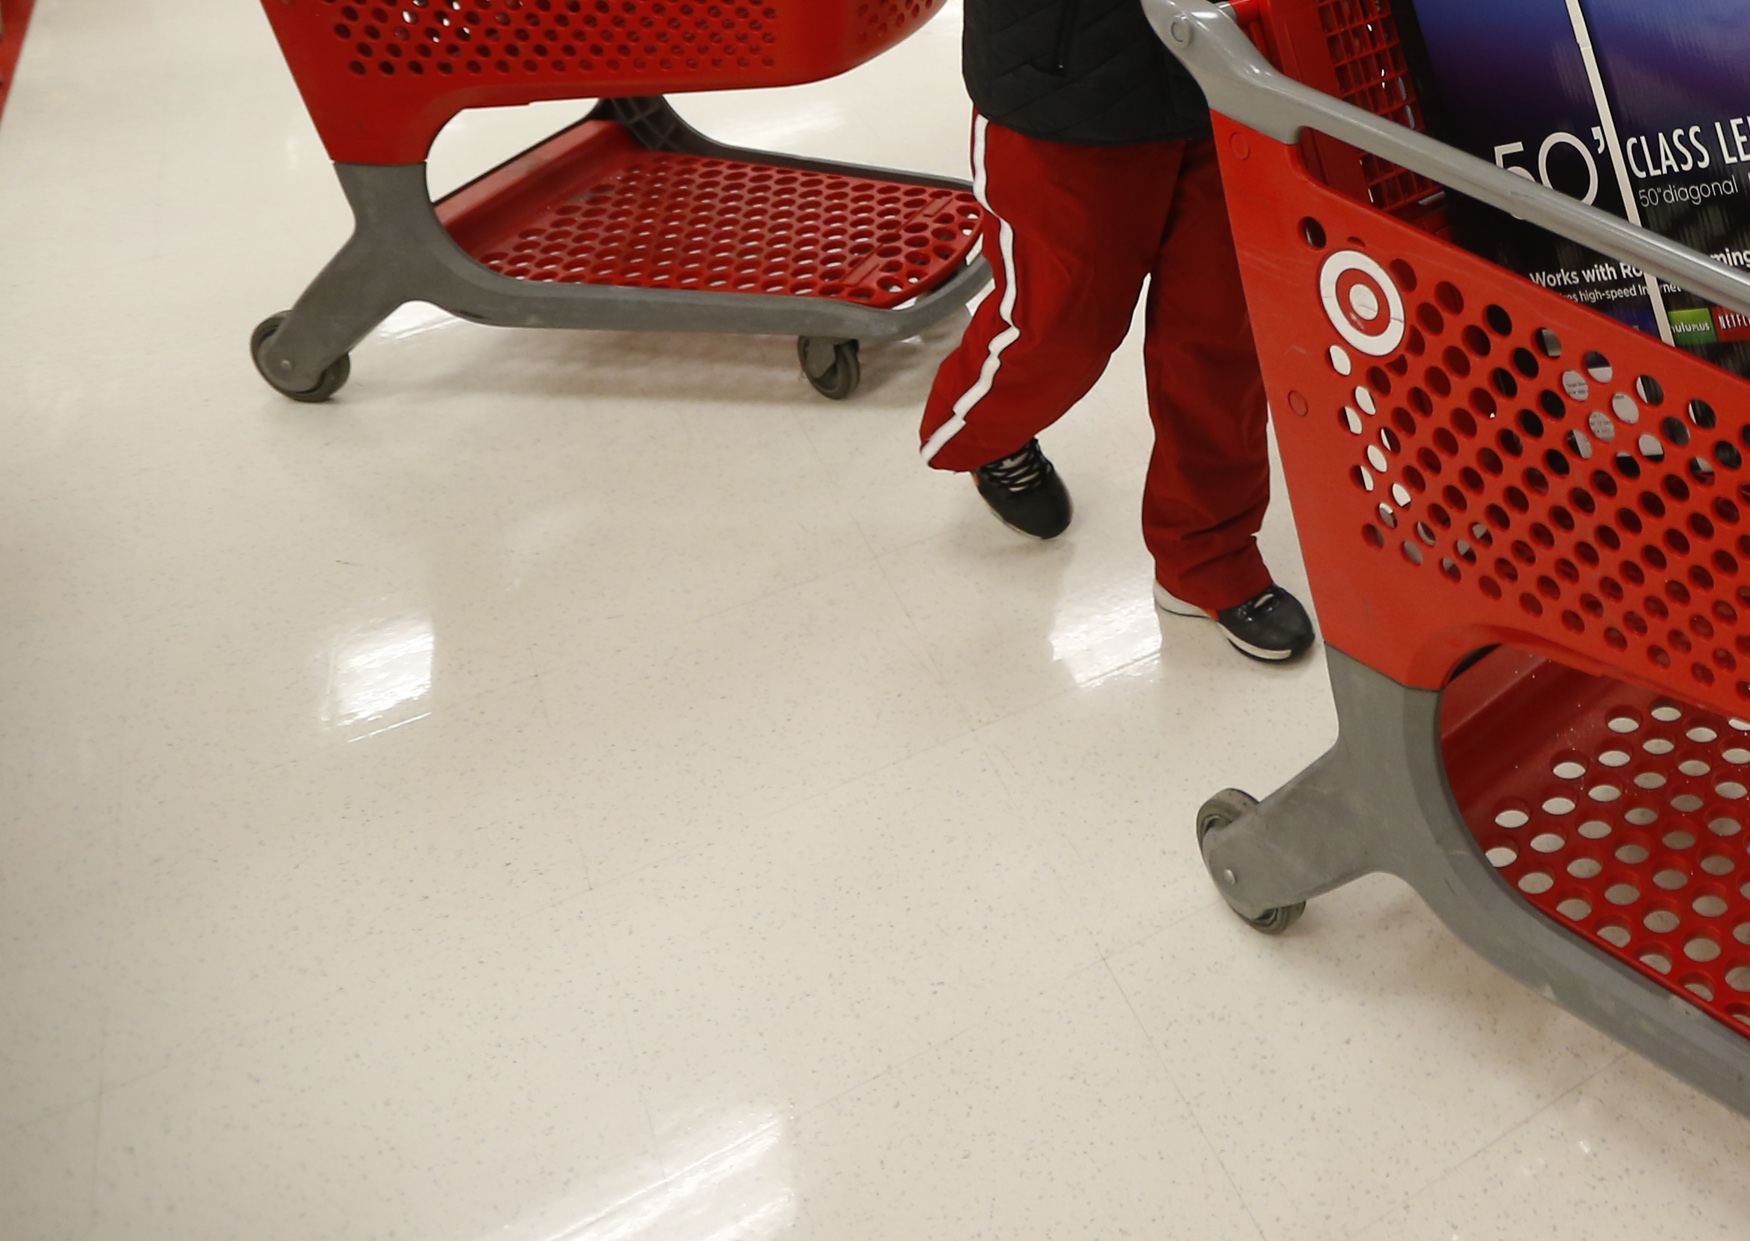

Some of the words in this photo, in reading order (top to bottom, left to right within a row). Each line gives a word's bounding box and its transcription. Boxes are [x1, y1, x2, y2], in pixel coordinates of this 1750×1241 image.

[1626, 125, 1711, 179] CLASS
[1529, 268, 1580, 288] Works
[1582, 263, 1618, 283] with
[1579, 284, 1637, 303] high-speed
